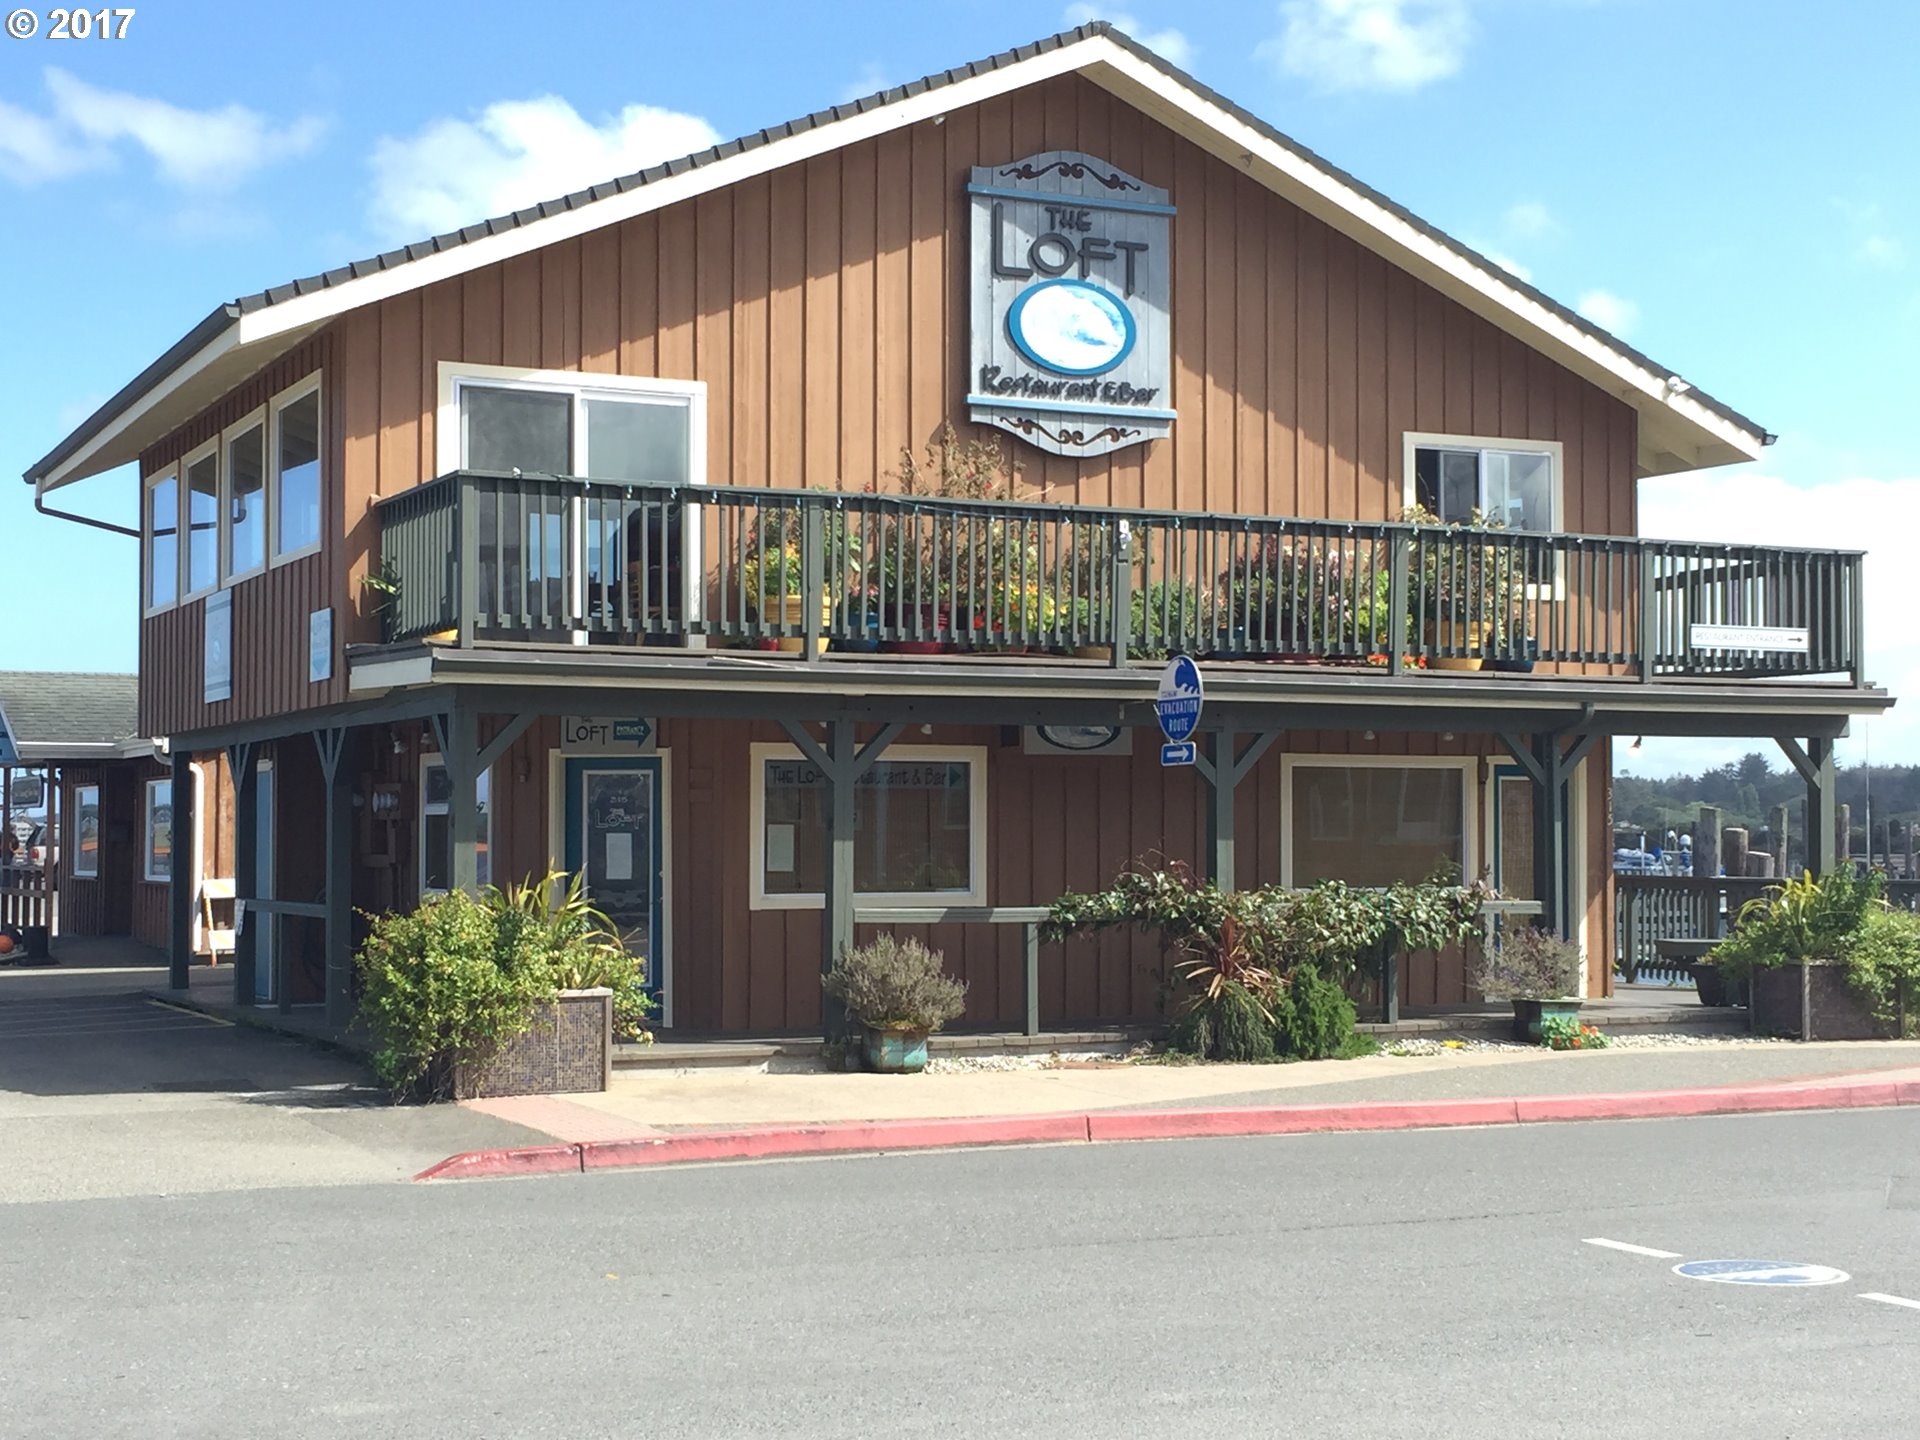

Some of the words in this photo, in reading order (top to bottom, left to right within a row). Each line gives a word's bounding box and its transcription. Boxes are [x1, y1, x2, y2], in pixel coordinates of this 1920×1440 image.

[1044, 206, 1092, 232] THE
[993, 202, 1150, 296] LOFT
[980, 364, 1101, 400] Restaurant
[1115, 381, 1160, 405] Bar
[1160, 700, 1198, 715] EVACUATION
[566, 717, 608, 746] LOFT
[1168, 718, 1189, 732] ROUTE
[769, 765, 794, 784] THE
[911, 769, 922, 785] &
[925, 767, 947, 785] Bar
[595, 808, 645, 830] LOFT
[1606, 787, 1614, 826] 315
